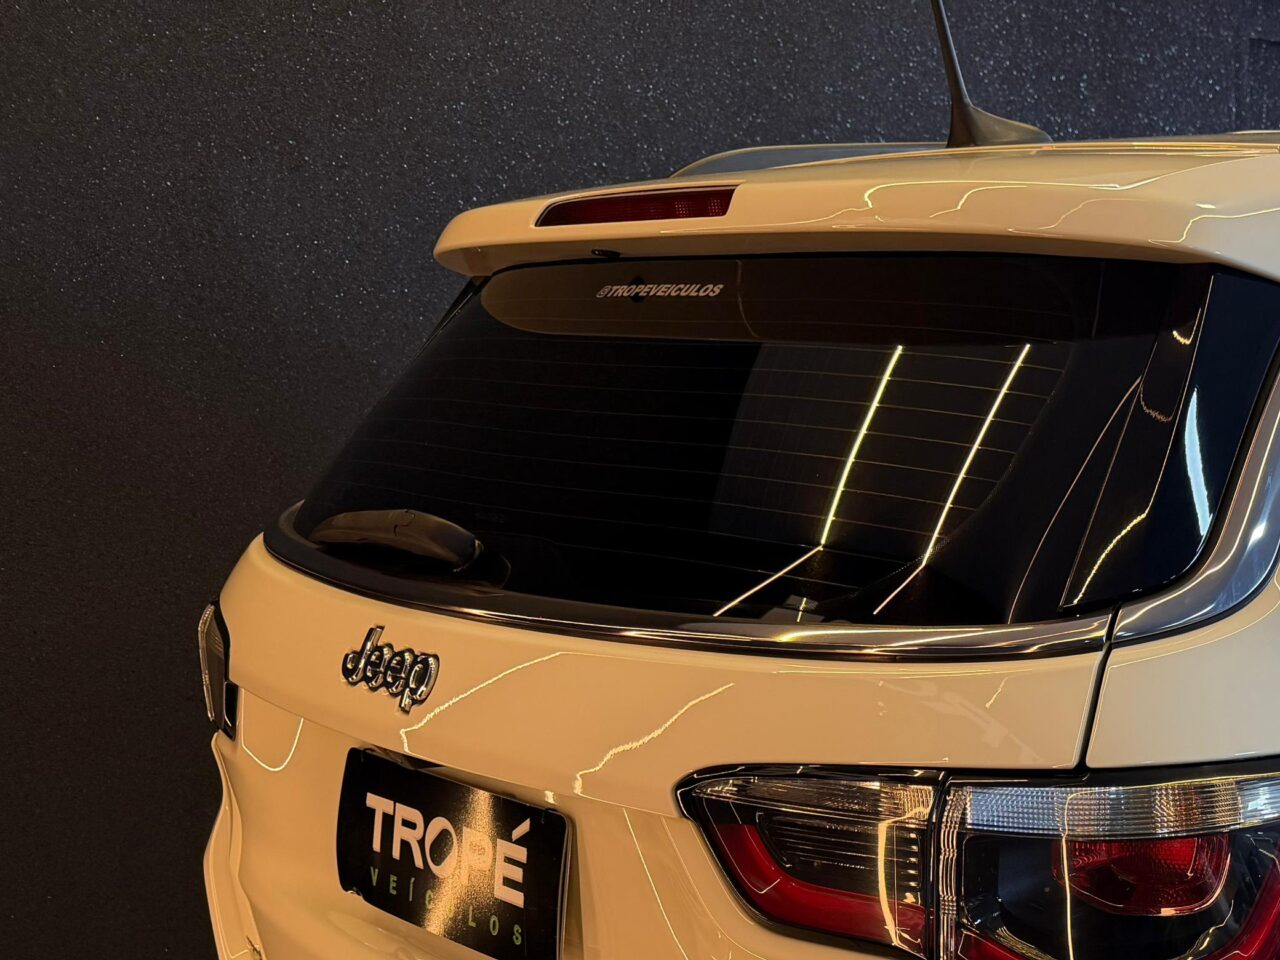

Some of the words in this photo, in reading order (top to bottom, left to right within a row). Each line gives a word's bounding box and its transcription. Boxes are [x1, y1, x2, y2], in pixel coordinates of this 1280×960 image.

[595, 283, 724, 299] @TROPEVEICULOS
[365, 792, 531, 908] TROPÉ
[370, 866, 523, 946] VEÍCLOS
